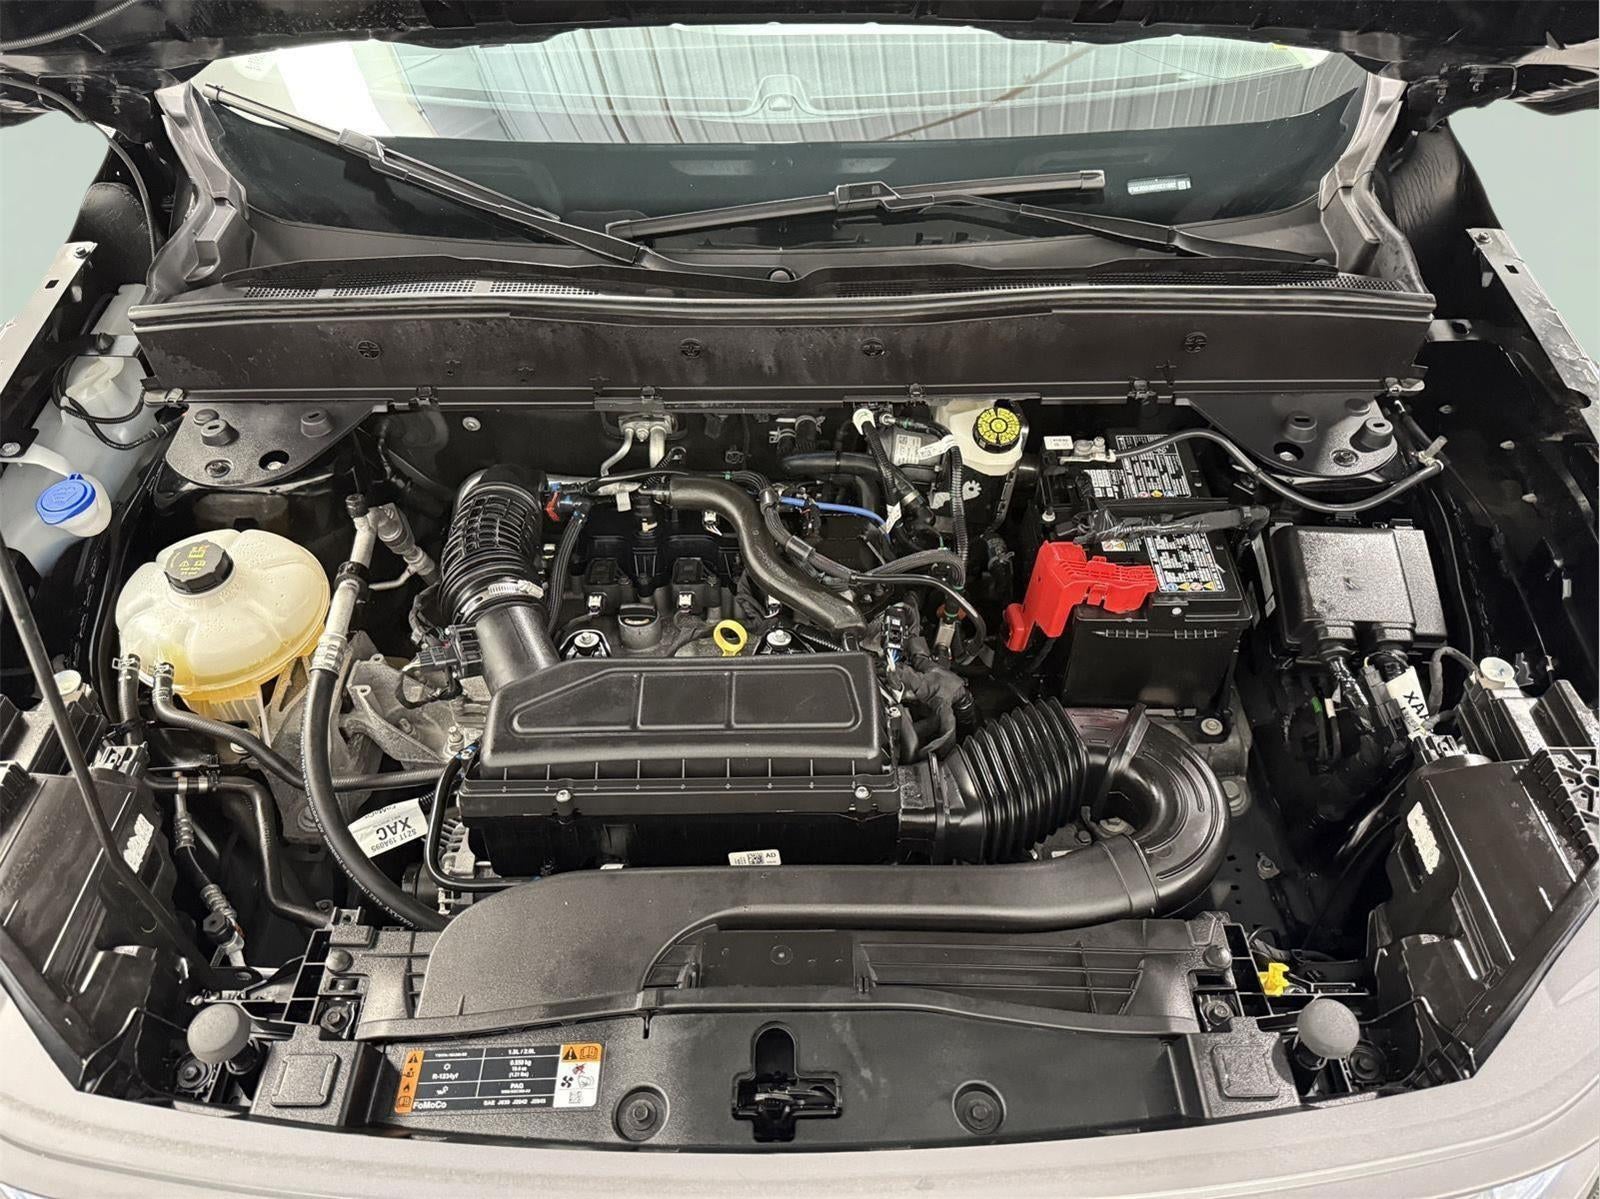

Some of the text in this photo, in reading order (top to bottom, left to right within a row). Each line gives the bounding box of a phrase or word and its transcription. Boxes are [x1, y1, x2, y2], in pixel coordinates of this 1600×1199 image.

[376, 816, 412, 841] XAC
[432, 1072, 459, 1081] R-1234yf
[412, 1100, 447, 1109] FoMoCo
